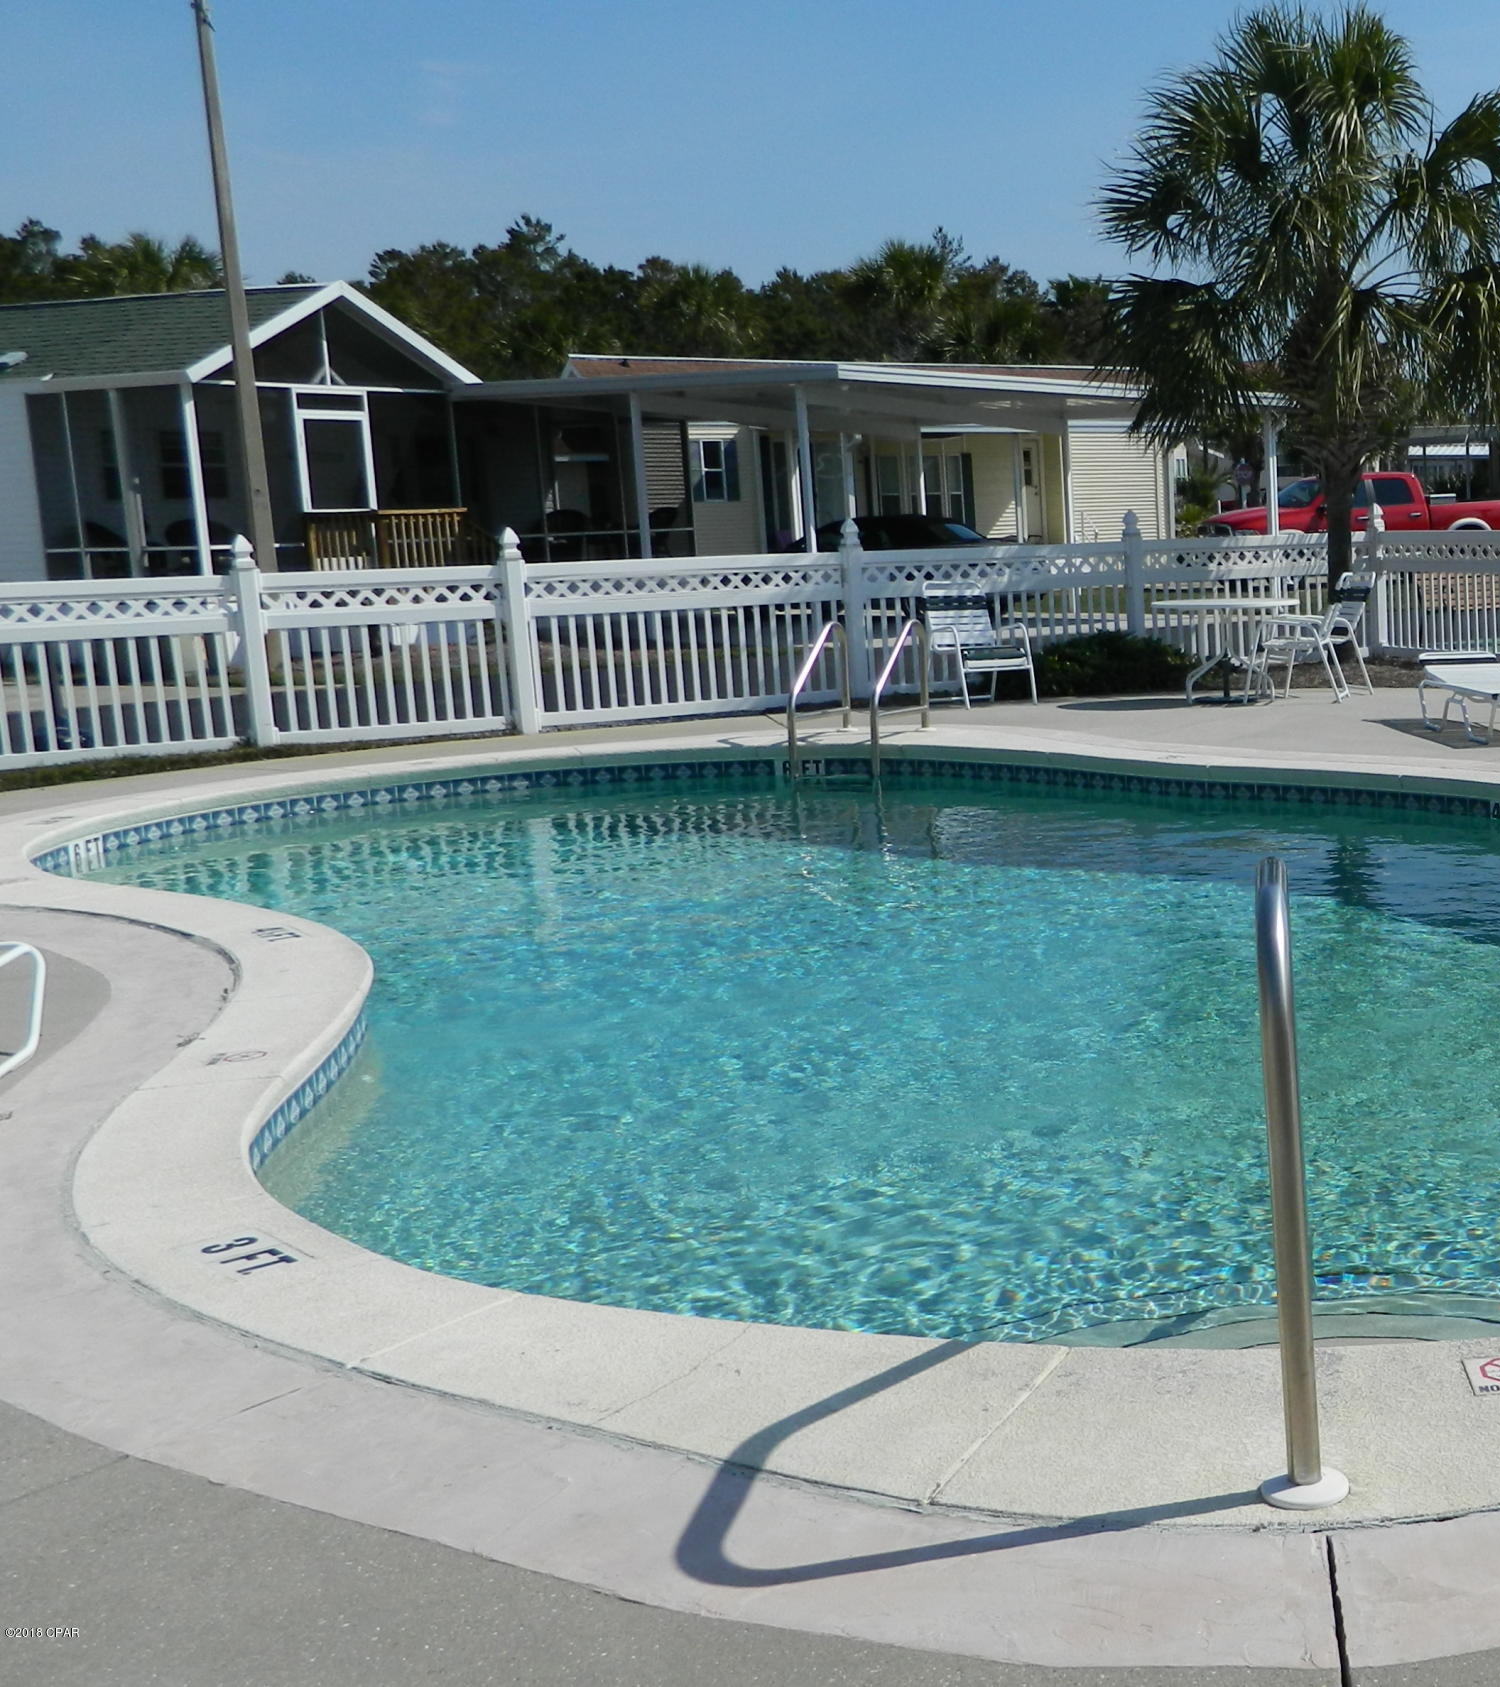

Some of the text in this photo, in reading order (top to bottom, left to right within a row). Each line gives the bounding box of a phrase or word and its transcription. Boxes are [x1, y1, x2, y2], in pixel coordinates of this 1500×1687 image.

[802, 759, 822, 775] FT
[200, 1236, 259, 1254] 3
[1478, 1385, 1500, 1393] NO
